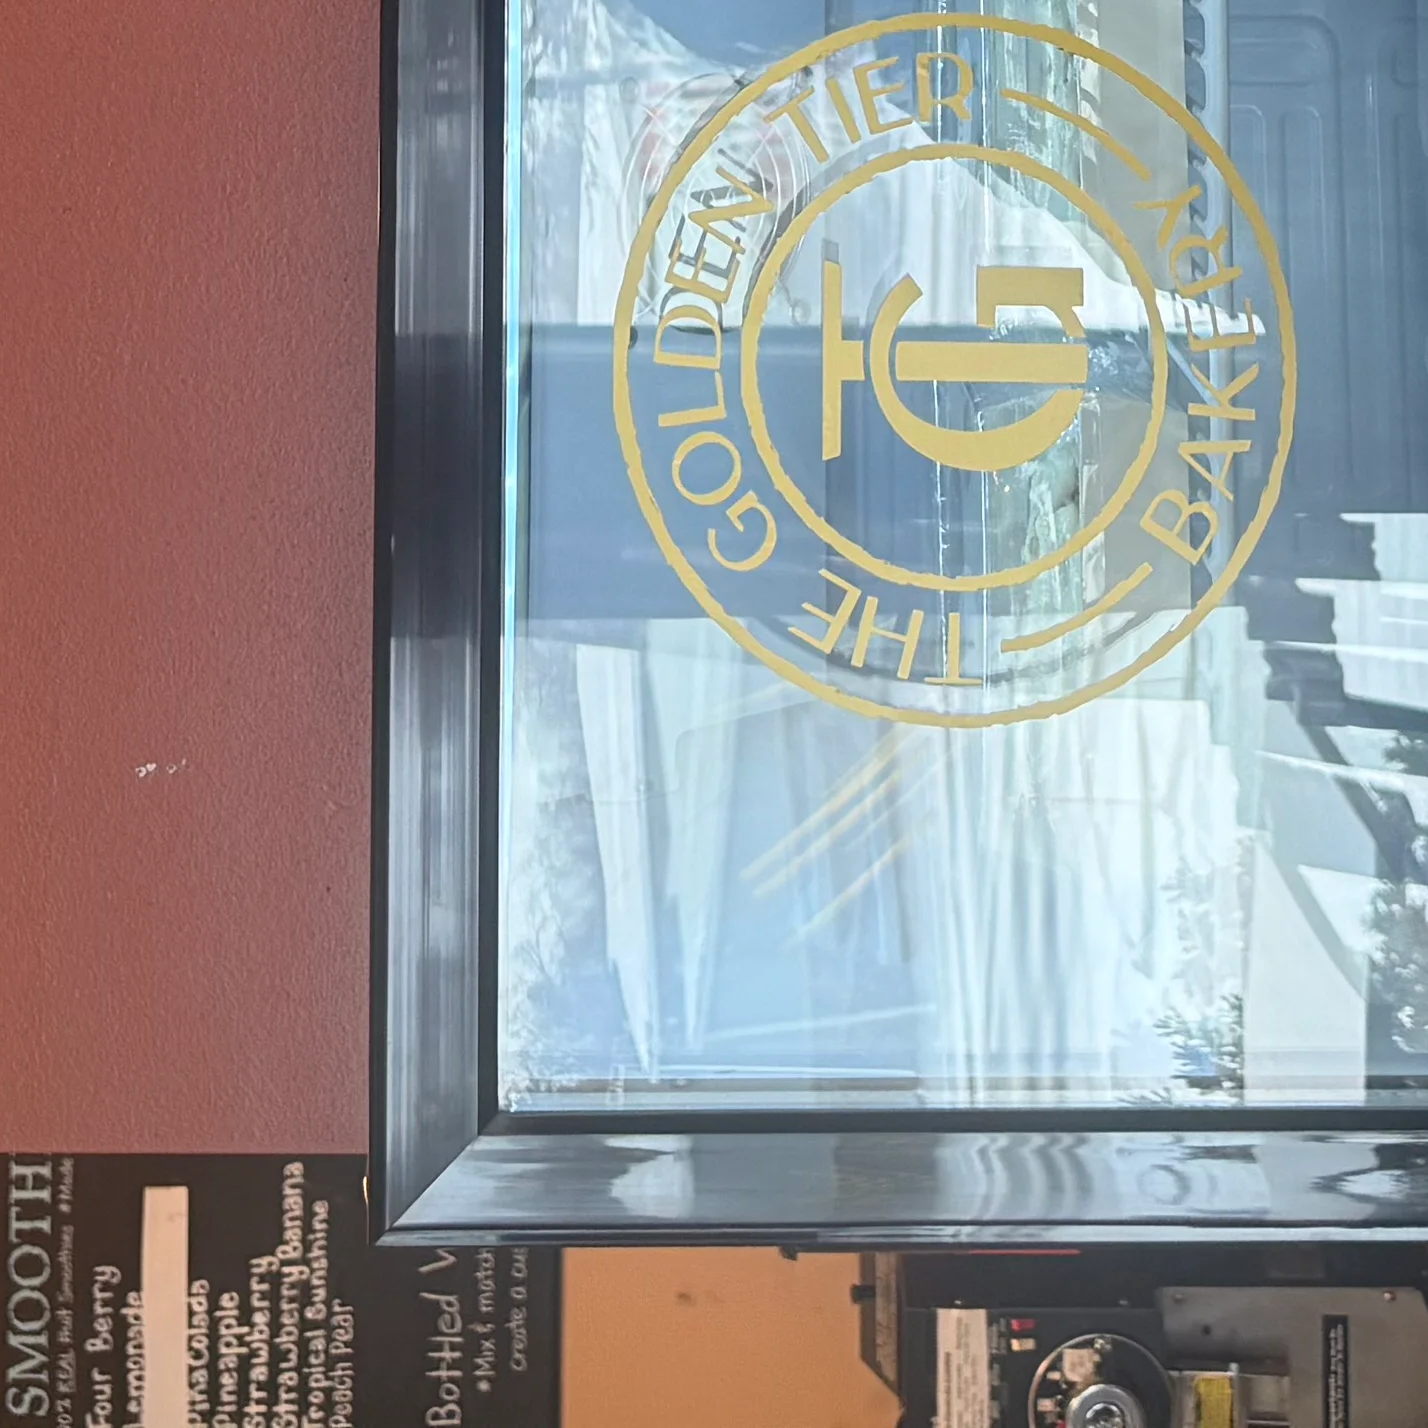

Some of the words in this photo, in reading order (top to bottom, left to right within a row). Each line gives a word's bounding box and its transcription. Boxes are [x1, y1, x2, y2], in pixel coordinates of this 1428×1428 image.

[763, 51, 976, 164] TIER
[653, 166, 776, 571] GOLDEN
[1132, 183, 1260, 565] BAKERY
[788, 568, 983, 685] THE
[275, 1161, 305, 1260] Banana
[305, 1200, 329, 1321] Sunshine
[5, 1153, 52, 1416] SMOOTH
[84, 1265, 121, 1352] Berry
[243, 1255, 280, 1428] Strawberry
[330, 1298, 354, 1354] Pear
[510, 1286, 528, 1299] a
[85, 1368, 113, 1428] Four
[213, 1291, 250, 1428] Pineapple
[272, 1265, 310, 1428] Strawberry
[302, 1329, 335, 1428] Tropical
[328, 1362, 355, 1428] Peach
[418, 1292, 464, 1427] Bottled
